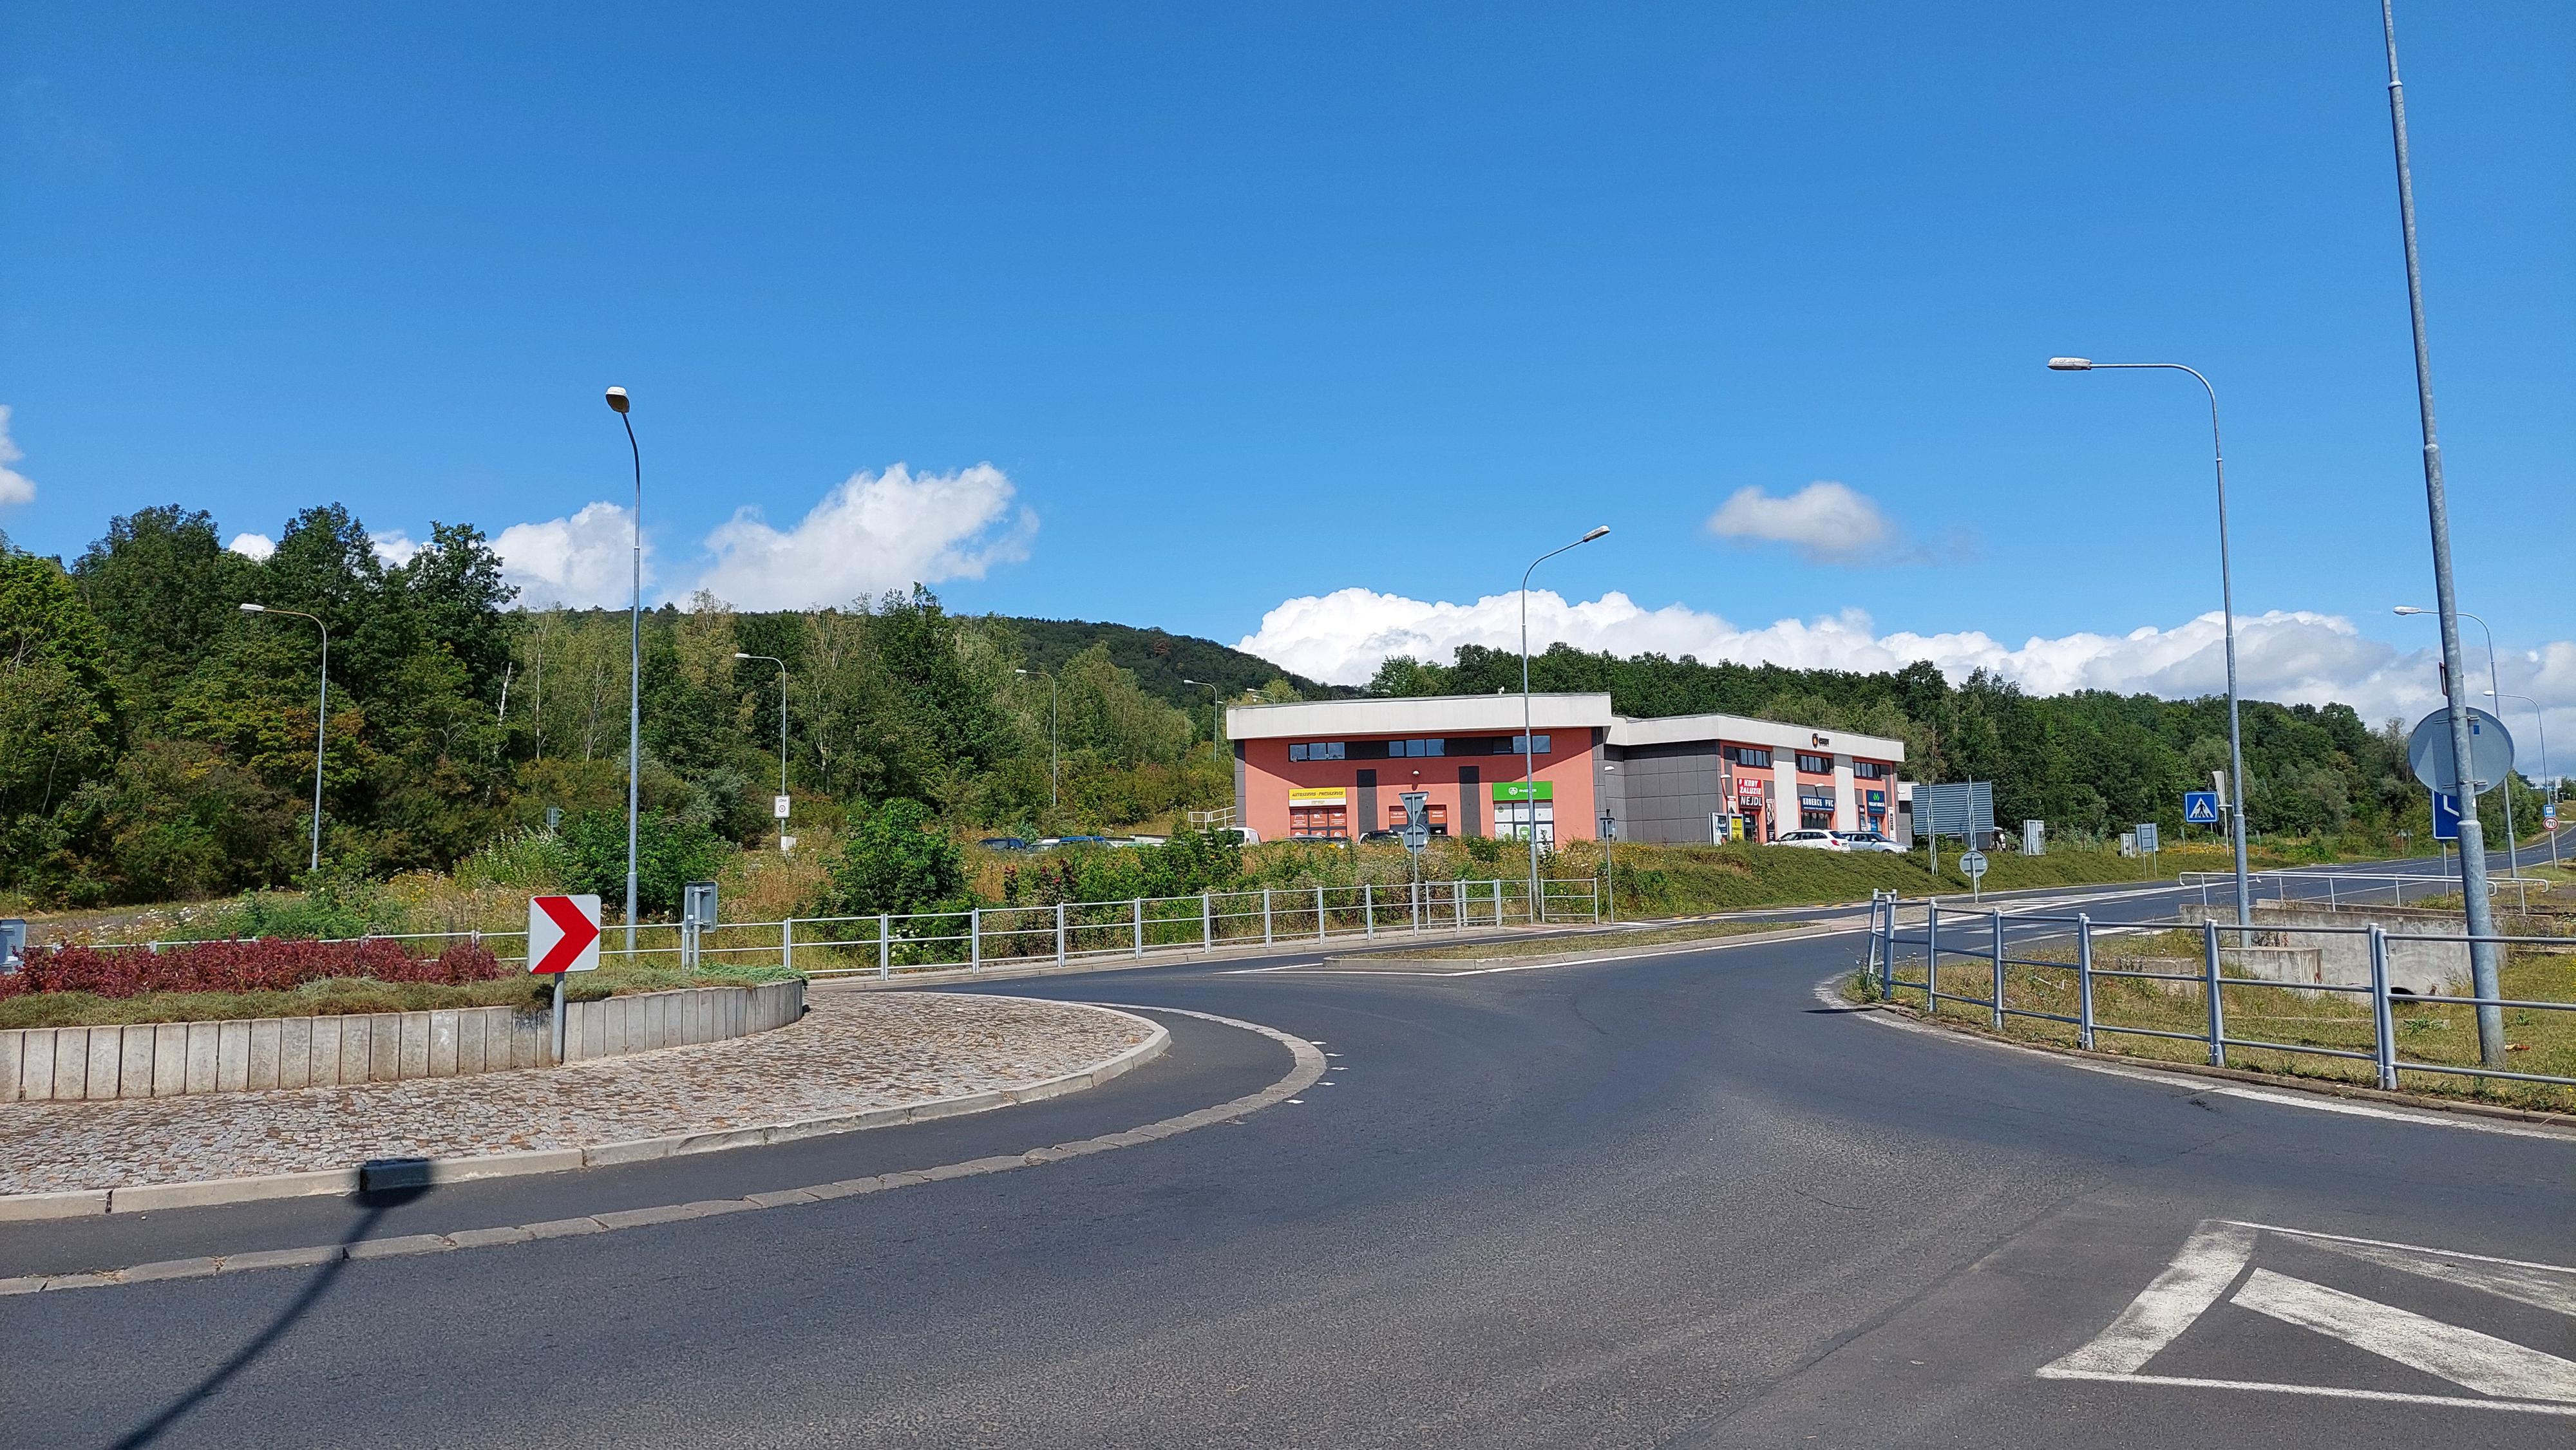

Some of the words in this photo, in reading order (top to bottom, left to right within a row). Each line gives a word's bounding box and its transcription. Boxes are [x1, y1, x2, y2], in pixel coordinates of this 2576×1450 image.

[1740, 796, 1763, 806] NEJDL
[1803, 798, 1823, 807] KOBERCE
[1824, 799, 1834, 807] PVC
